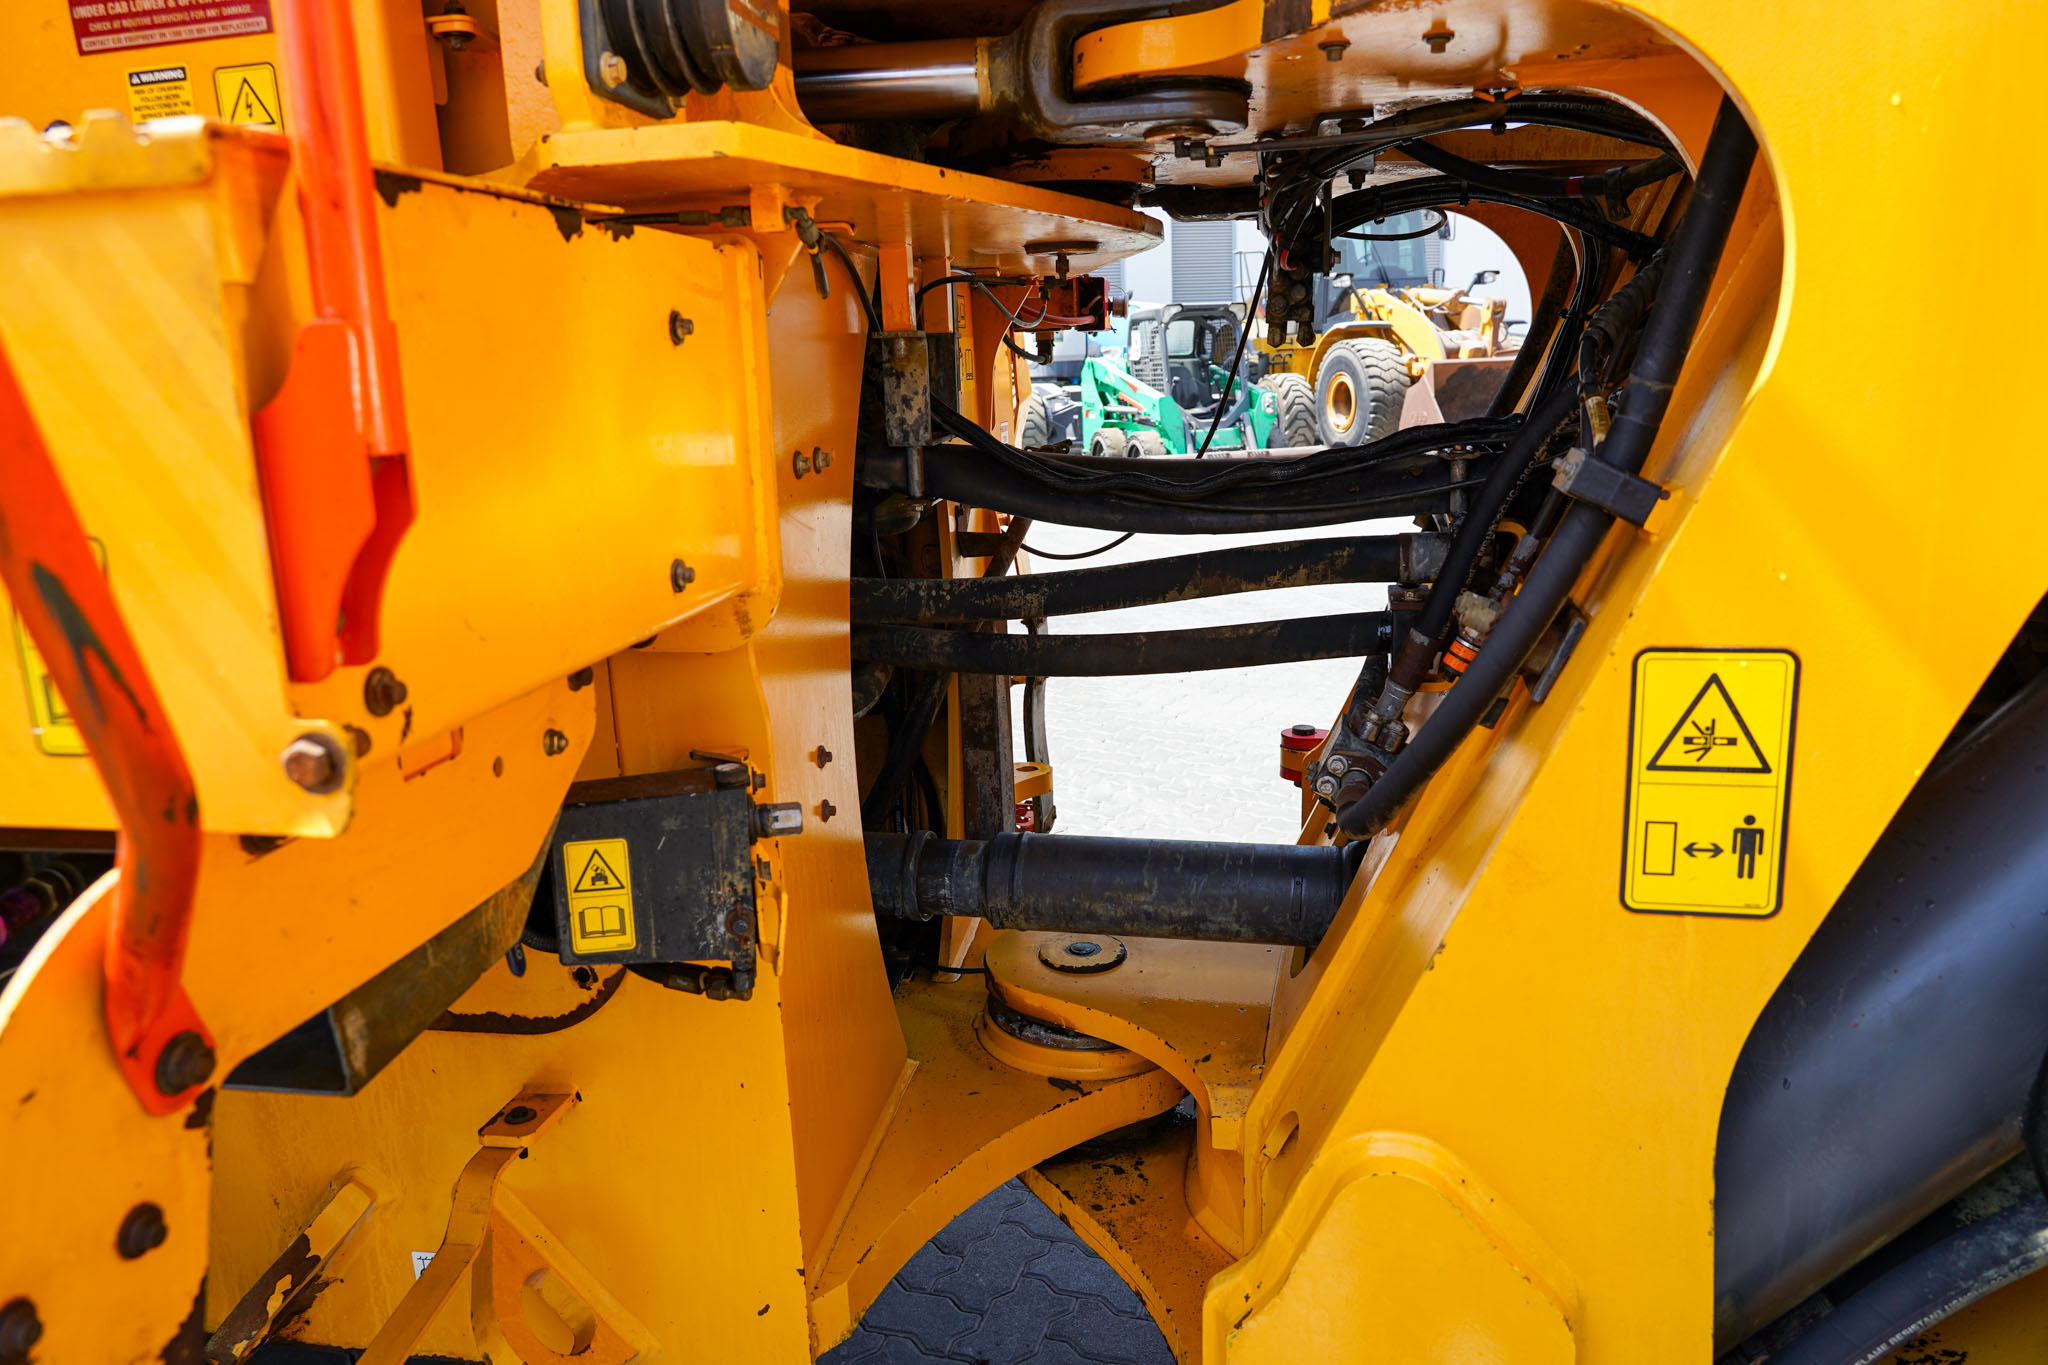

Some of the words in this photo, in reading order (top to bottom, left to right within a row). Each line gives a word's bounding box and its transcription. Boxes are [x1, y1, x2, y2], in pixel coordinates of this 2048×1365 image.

[72, 4, 106, 19] UNDER
[106, 1, 129, 15] CAB
[129, 0, 166, 12] LOWER
[88, 20, 112, 32] CHECK
[137, 68, 186, 84] WARNING
